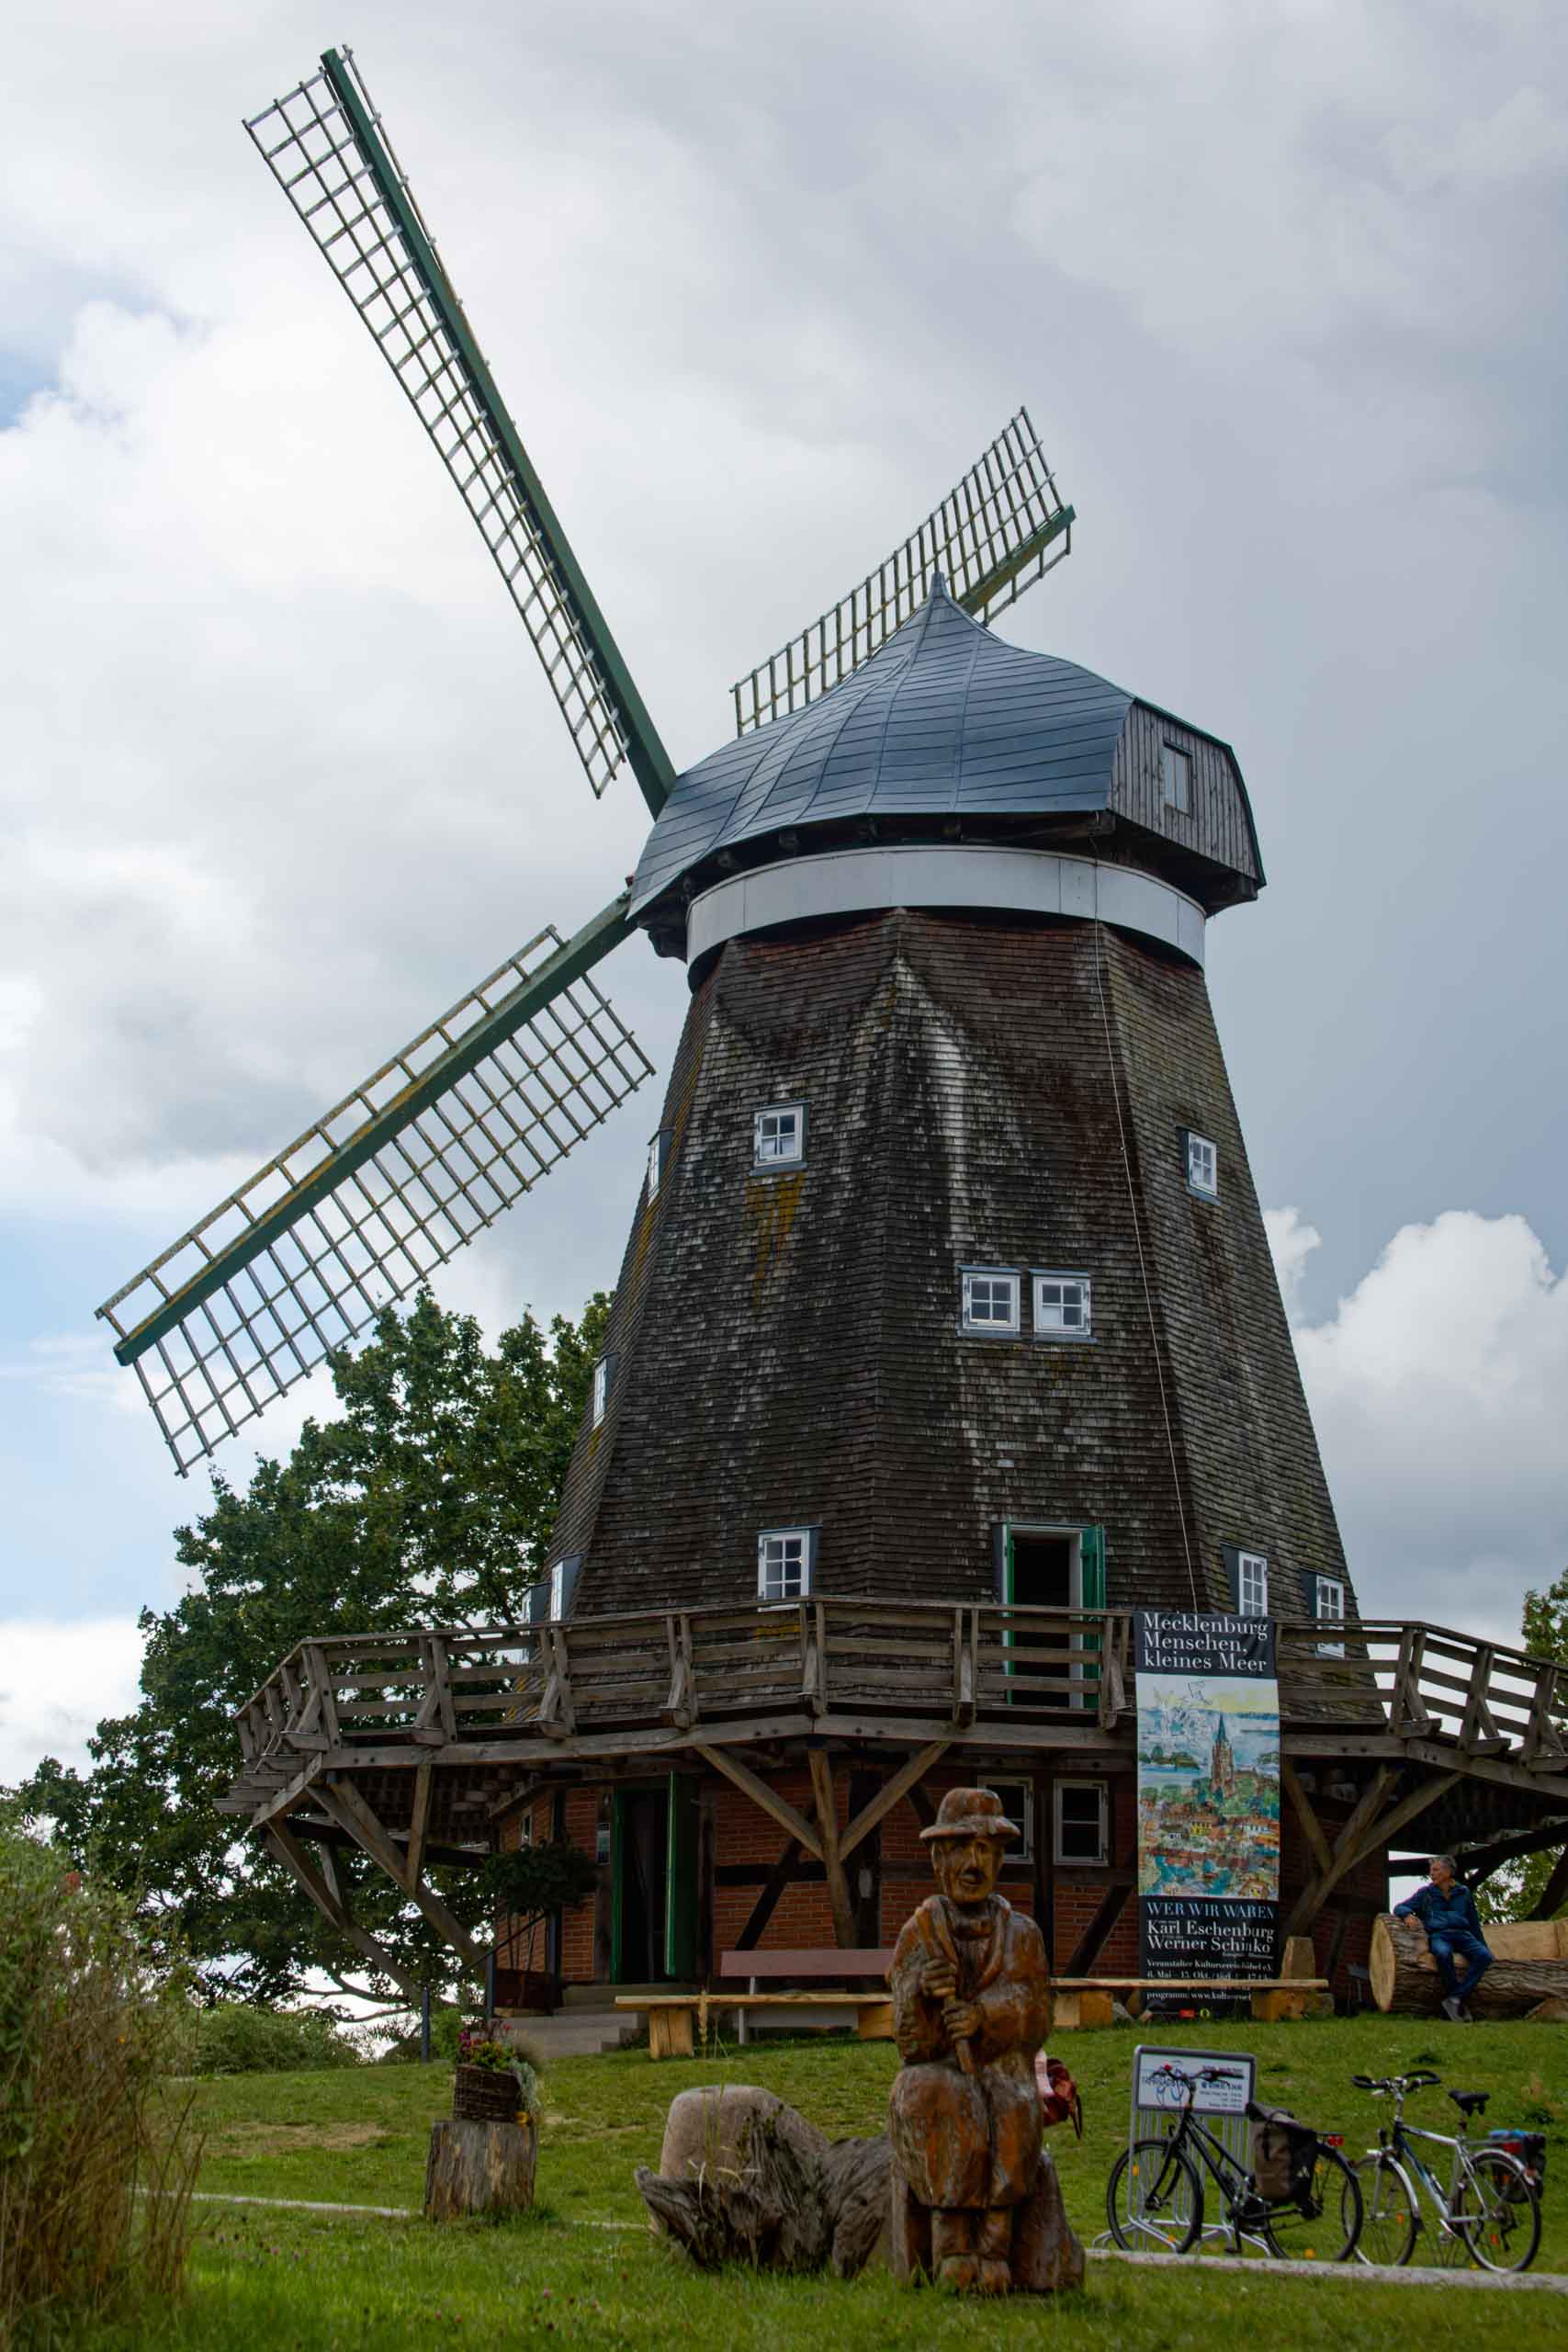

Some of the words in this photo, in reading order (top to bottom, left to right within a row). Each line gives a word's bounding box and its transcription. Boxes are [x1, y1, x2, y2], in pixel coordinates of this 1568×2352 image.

[1144, 1611, 1268, 1640] Mecklenburg
[1144, 1631, 1247, 1655] Menschen,
[1145, 1649, 1212, 1669] kleines
[1219, 1653, 1267, 1671] Meer
[1147, 1902, 1184, 1916] WER
[1189, 1903, 1220, 1917] WIR
[1224, 1905, 1274, 1919] WAREN
[1147, 1919, 1180, 1934] Karl
[1187, 1920, 1274, 1943] Eschenburg
[1147, 1935, 1207, 1950] Werner
[1211, 1936, 1270, 1954] Schinko
